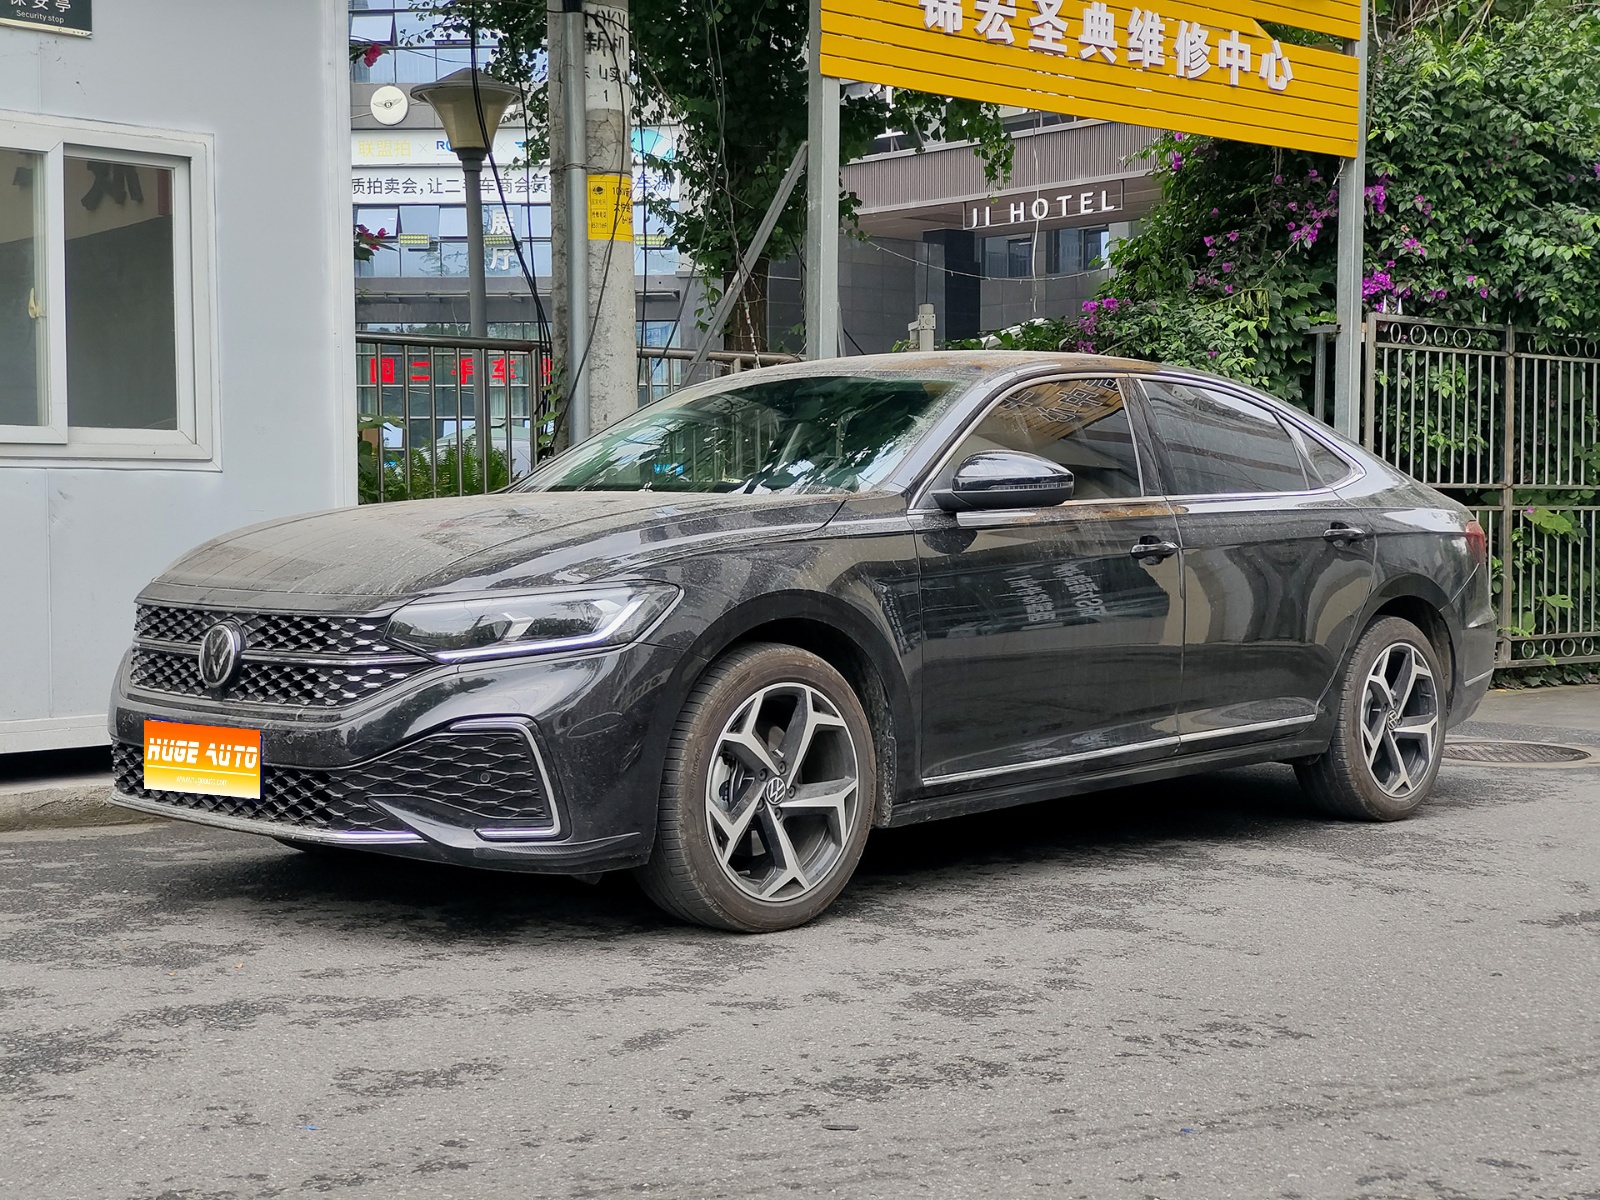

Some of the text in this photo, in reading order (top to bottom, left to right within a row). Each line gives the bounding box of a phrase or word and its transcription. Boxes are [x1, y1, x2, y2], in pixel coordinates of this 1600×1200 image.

[16, 9, 65, 24] Security stop
[358, 139, 411, 158] 联盟拍
[971, 190, 1116, 228] JI HOTEL
